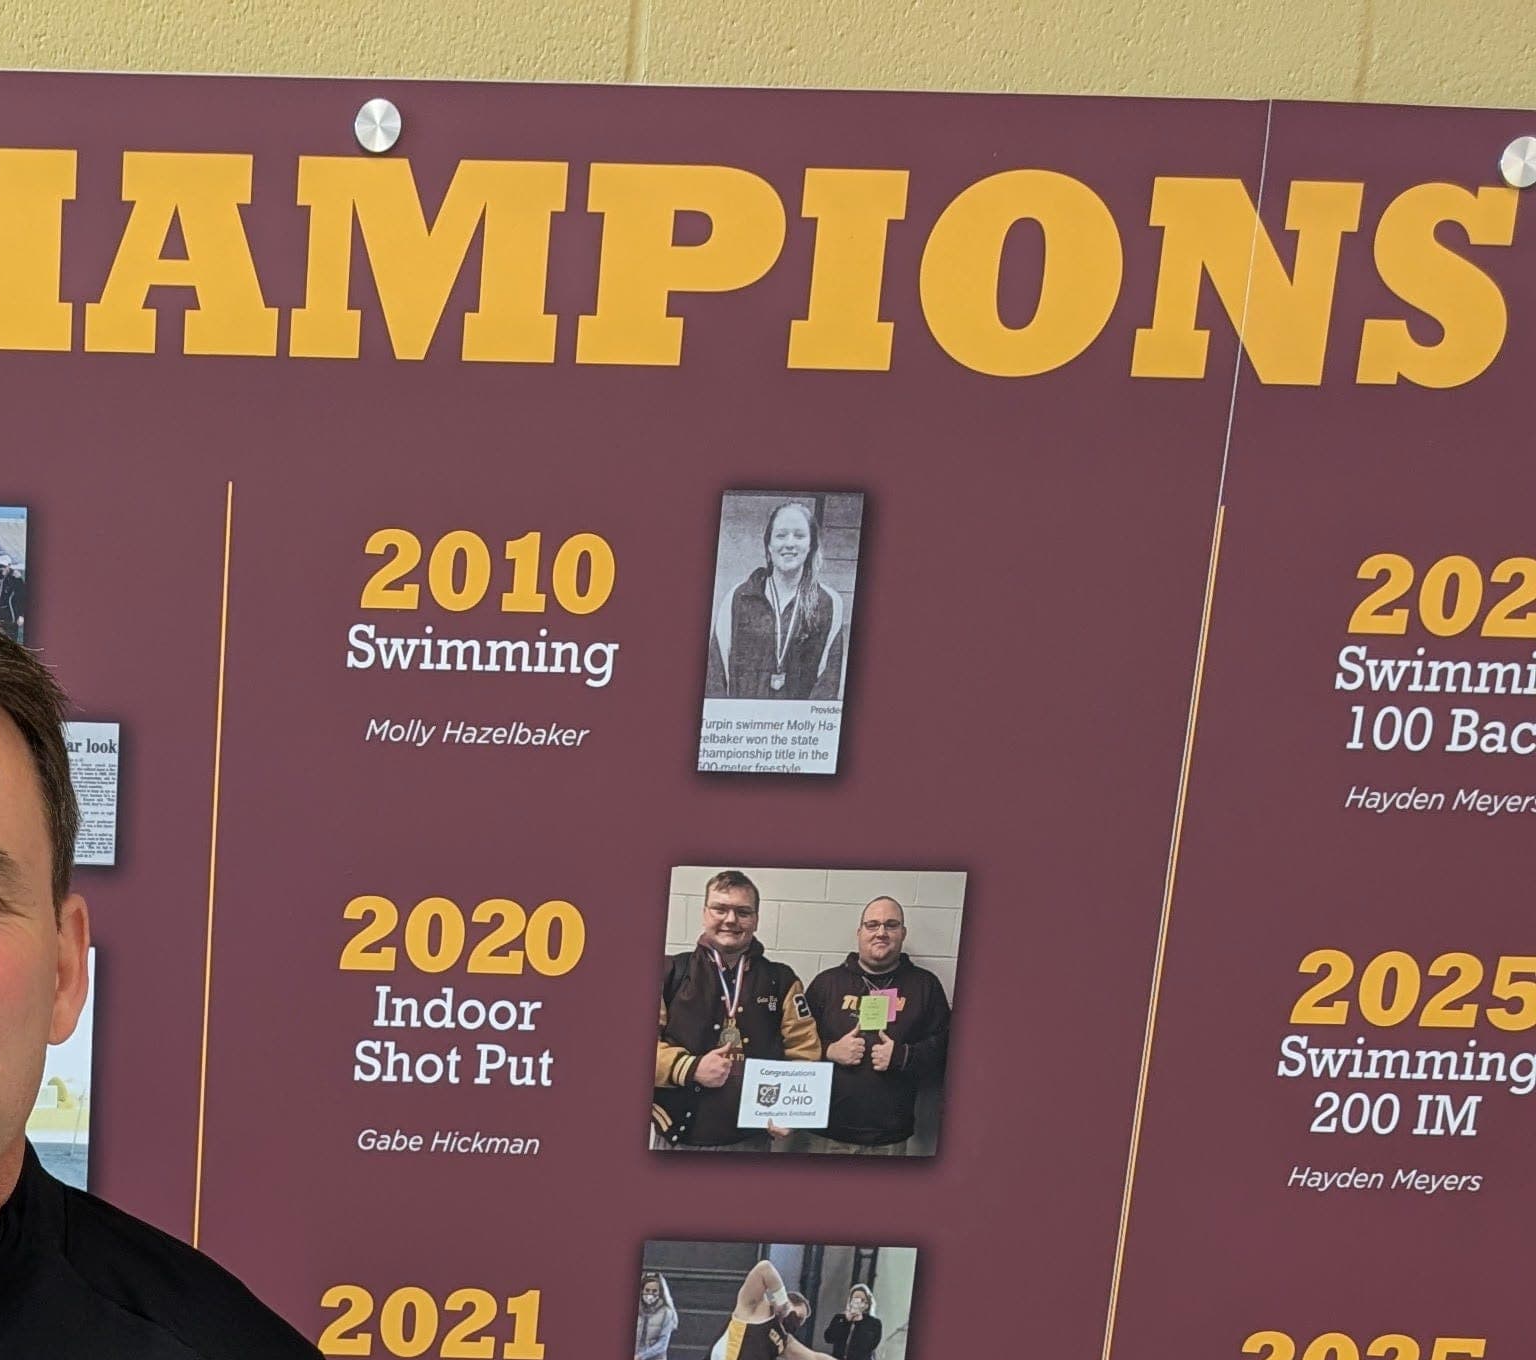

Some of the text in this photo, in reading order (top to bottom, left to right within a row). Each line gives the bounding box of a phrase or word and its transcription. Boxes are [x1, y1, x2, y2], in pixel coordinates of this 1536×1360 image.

[361, 528, 616, 615] 2010
[1348, 553, 1536, 639] 202
[347, 624, 619, 688] Swimming
[1336, 646, 1536, 695] Swimmi
[87, 738, 118, 754] look
[365, 719, 590, 748] Molly Hazelbaker
[736, 720, 784, 731] swimmer
[787, 720, 816, 733] Molly
[746, 736, 768, 745] won
[771, 734, 787, 745] the
[791, 735, 819, 746] state
[1346, 706, 1536, 754] 100 Bac
[774, 749, 796, 760] title
[799, 750, 809, 760] in
[811, 750, 829, 760] the
[1345, 786, 1444, 814] Hayden
[339, 895, 585, 977] 2020
[373, 985, 542, 1031] Indoor
[1289, 949, 1536, 1032] 2025
[354, 1039, 553, 1087] Shot Put
[760, 1068, 816, 1077] Congratulations
[1277, 1035, 1536, 1094] Swimming
[782, 1096, 812, 1106] OHIO
[789, 1084, 808, 1093] ALL
[1309, 1091, 1482, 1136] 200 IM
[357, 1128, 540, 1155] Gabe Hickman
[1287, 1167, 1482, 1193] Hayden Meyers
[317, 1285, 545, 1360] 2021
